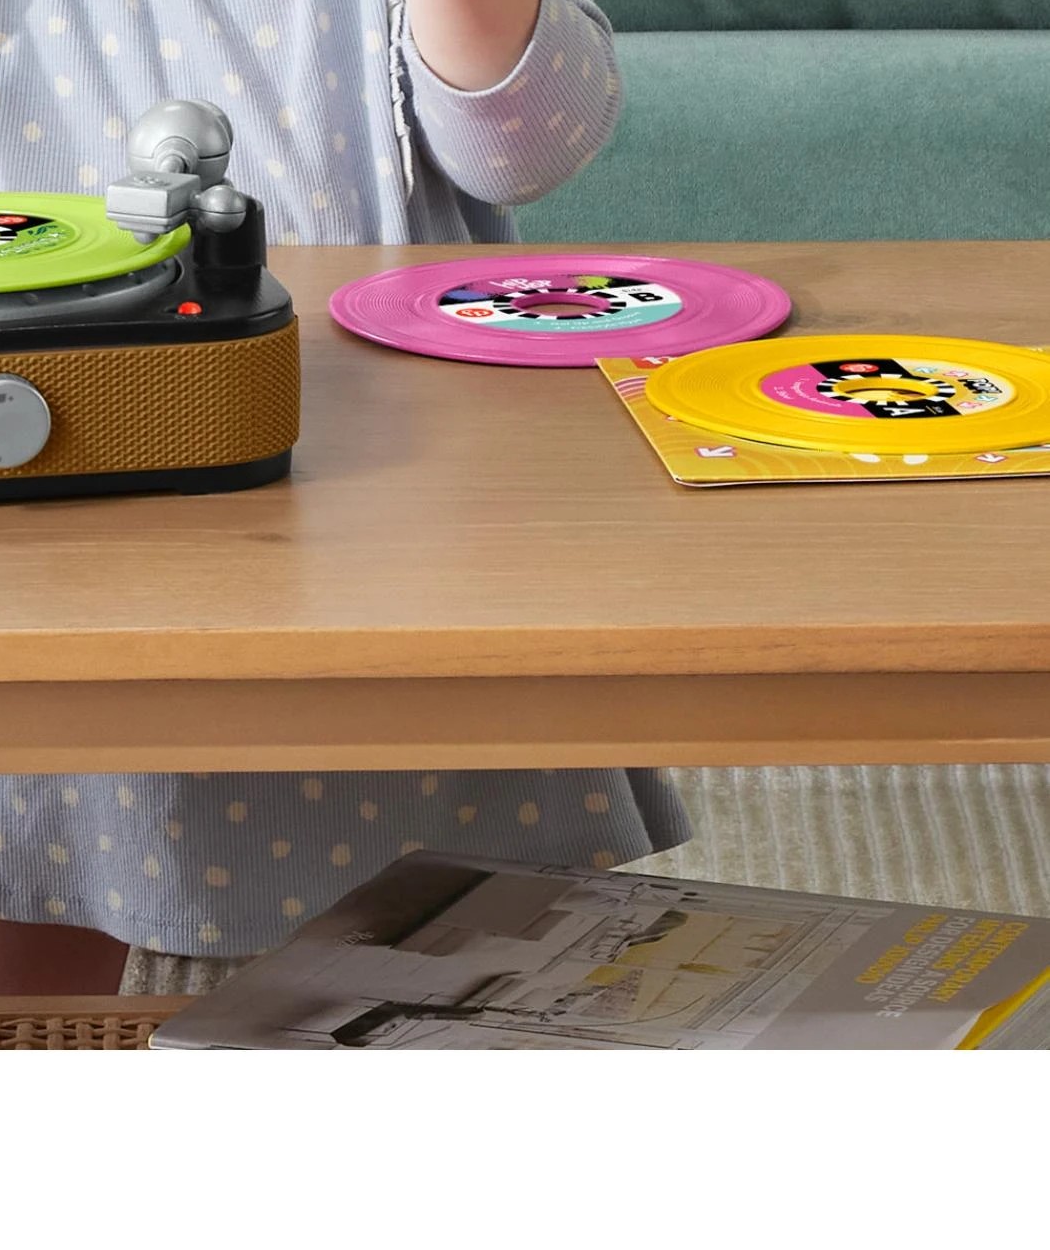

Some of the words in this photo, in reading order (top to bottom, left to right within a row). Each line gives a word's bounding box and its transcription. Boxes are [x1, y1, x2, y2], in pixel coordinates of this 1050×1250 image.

[628, 292, 663, 302] B
[883, 407, 926, 417] A
[896, 935, 951, 971] DESIGN
[876, 978, 938, 1018] SOURCE
